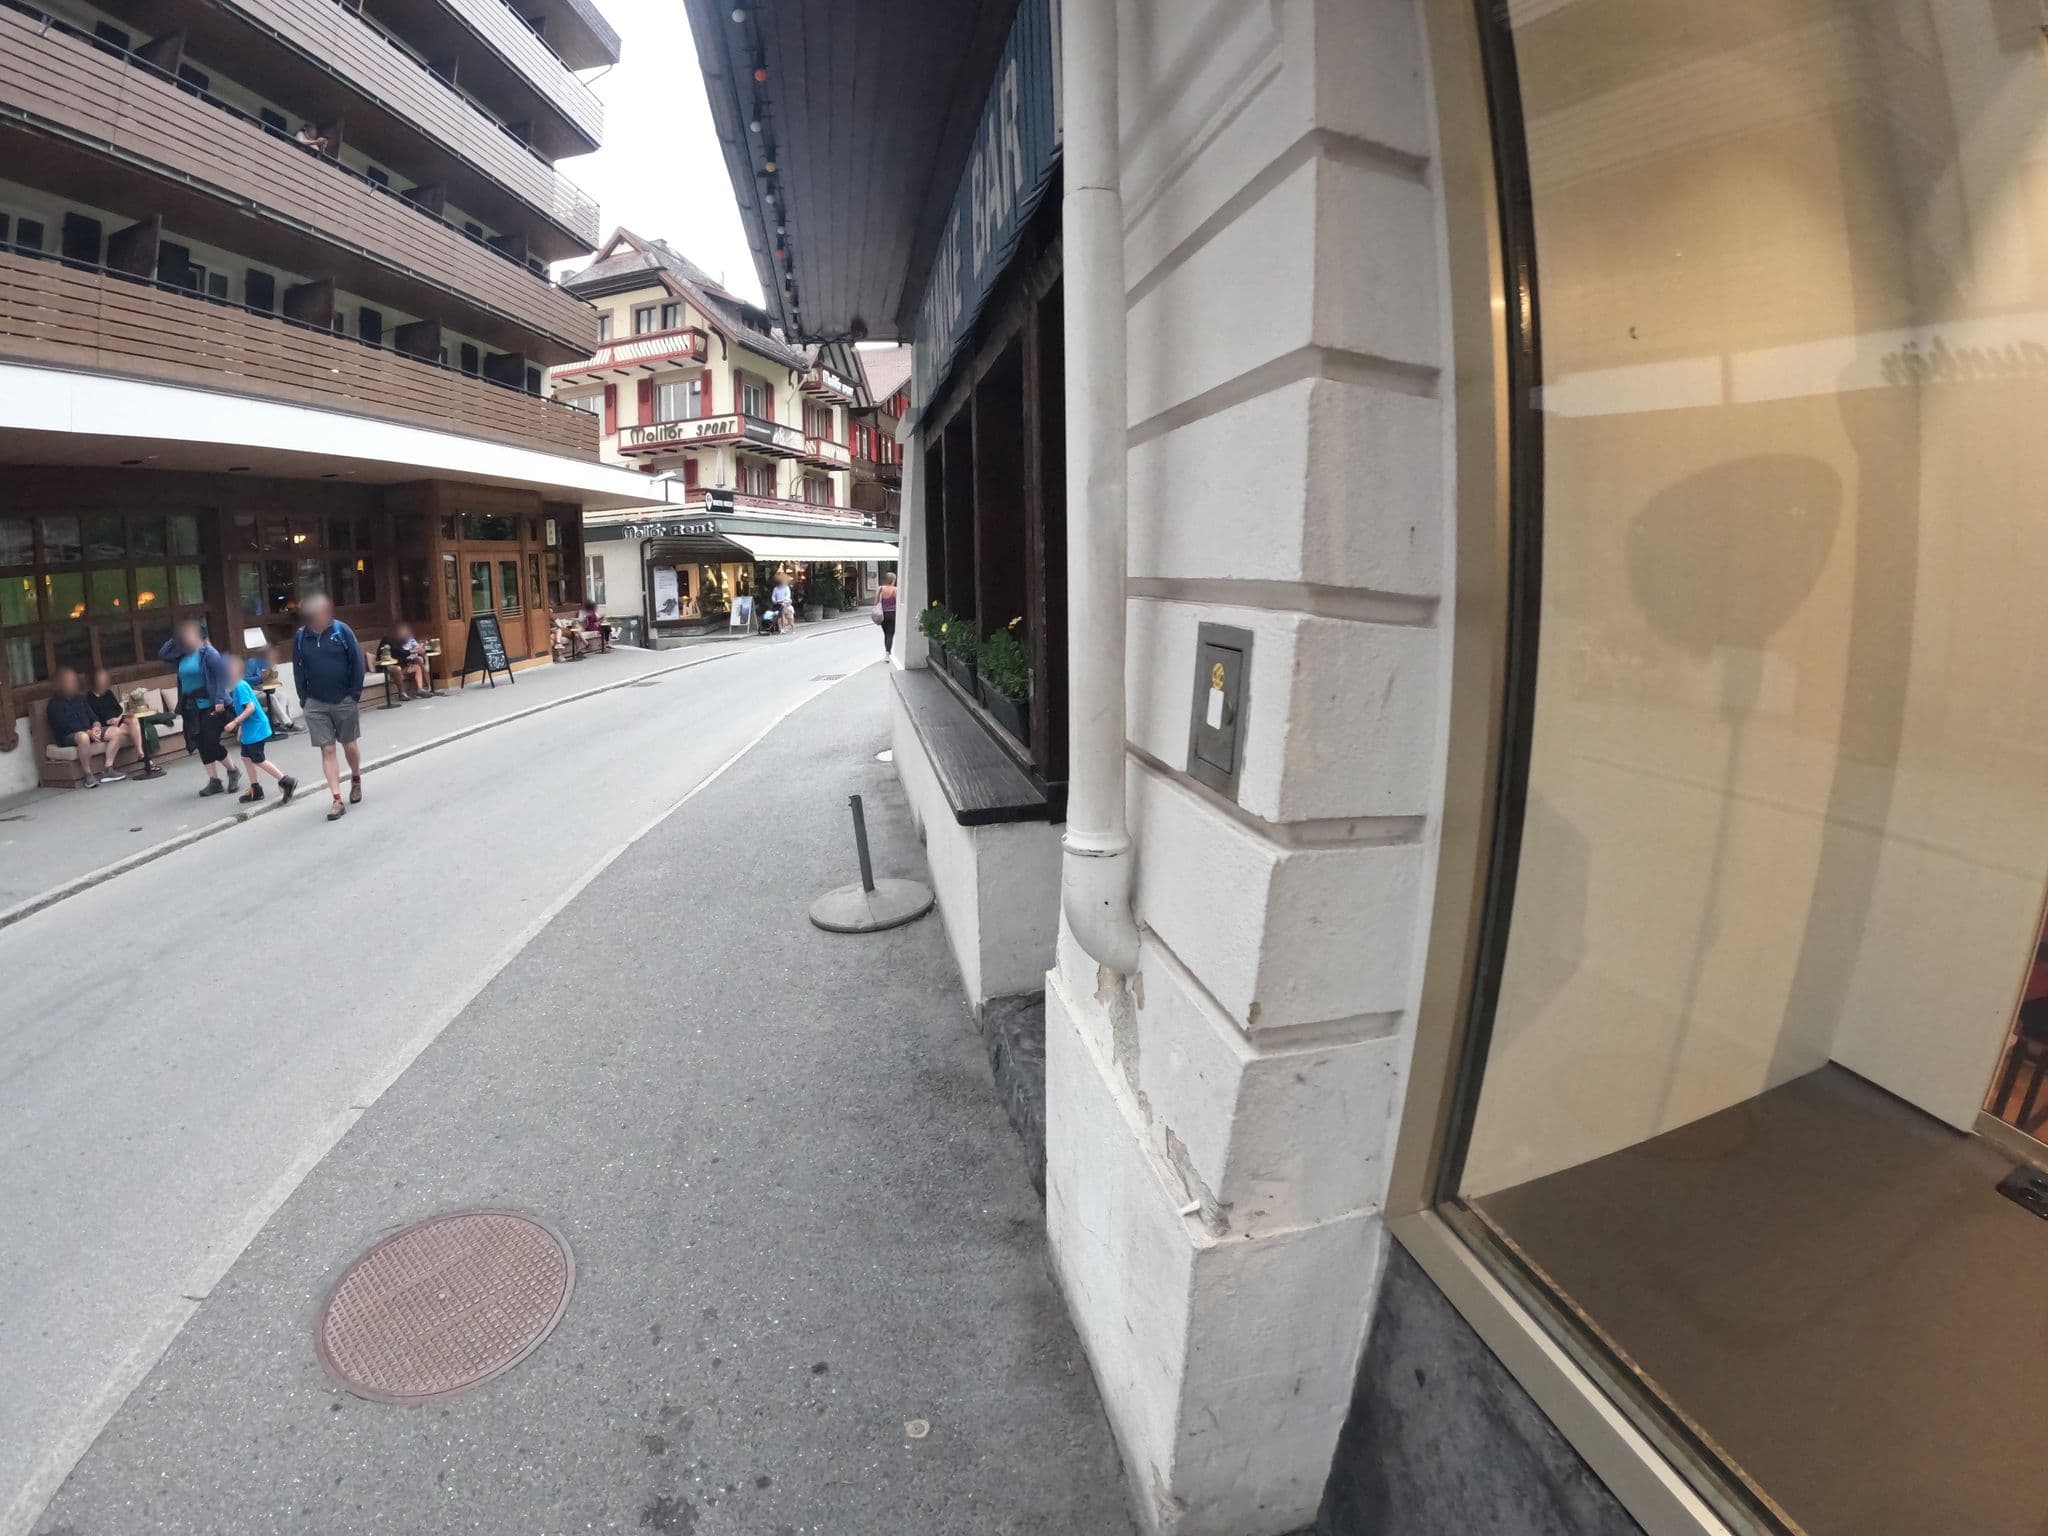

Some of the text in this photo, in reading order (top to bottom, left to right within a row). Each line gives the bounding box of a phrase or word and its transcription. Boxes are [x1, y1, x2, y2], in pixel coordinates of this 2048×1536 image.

[972, 59, 1023, 280] BAR
[630, 423, 683, 444] Molitor
[697, 421, 735, 437] SPORT
[670, 521, 714, 536] Rent
